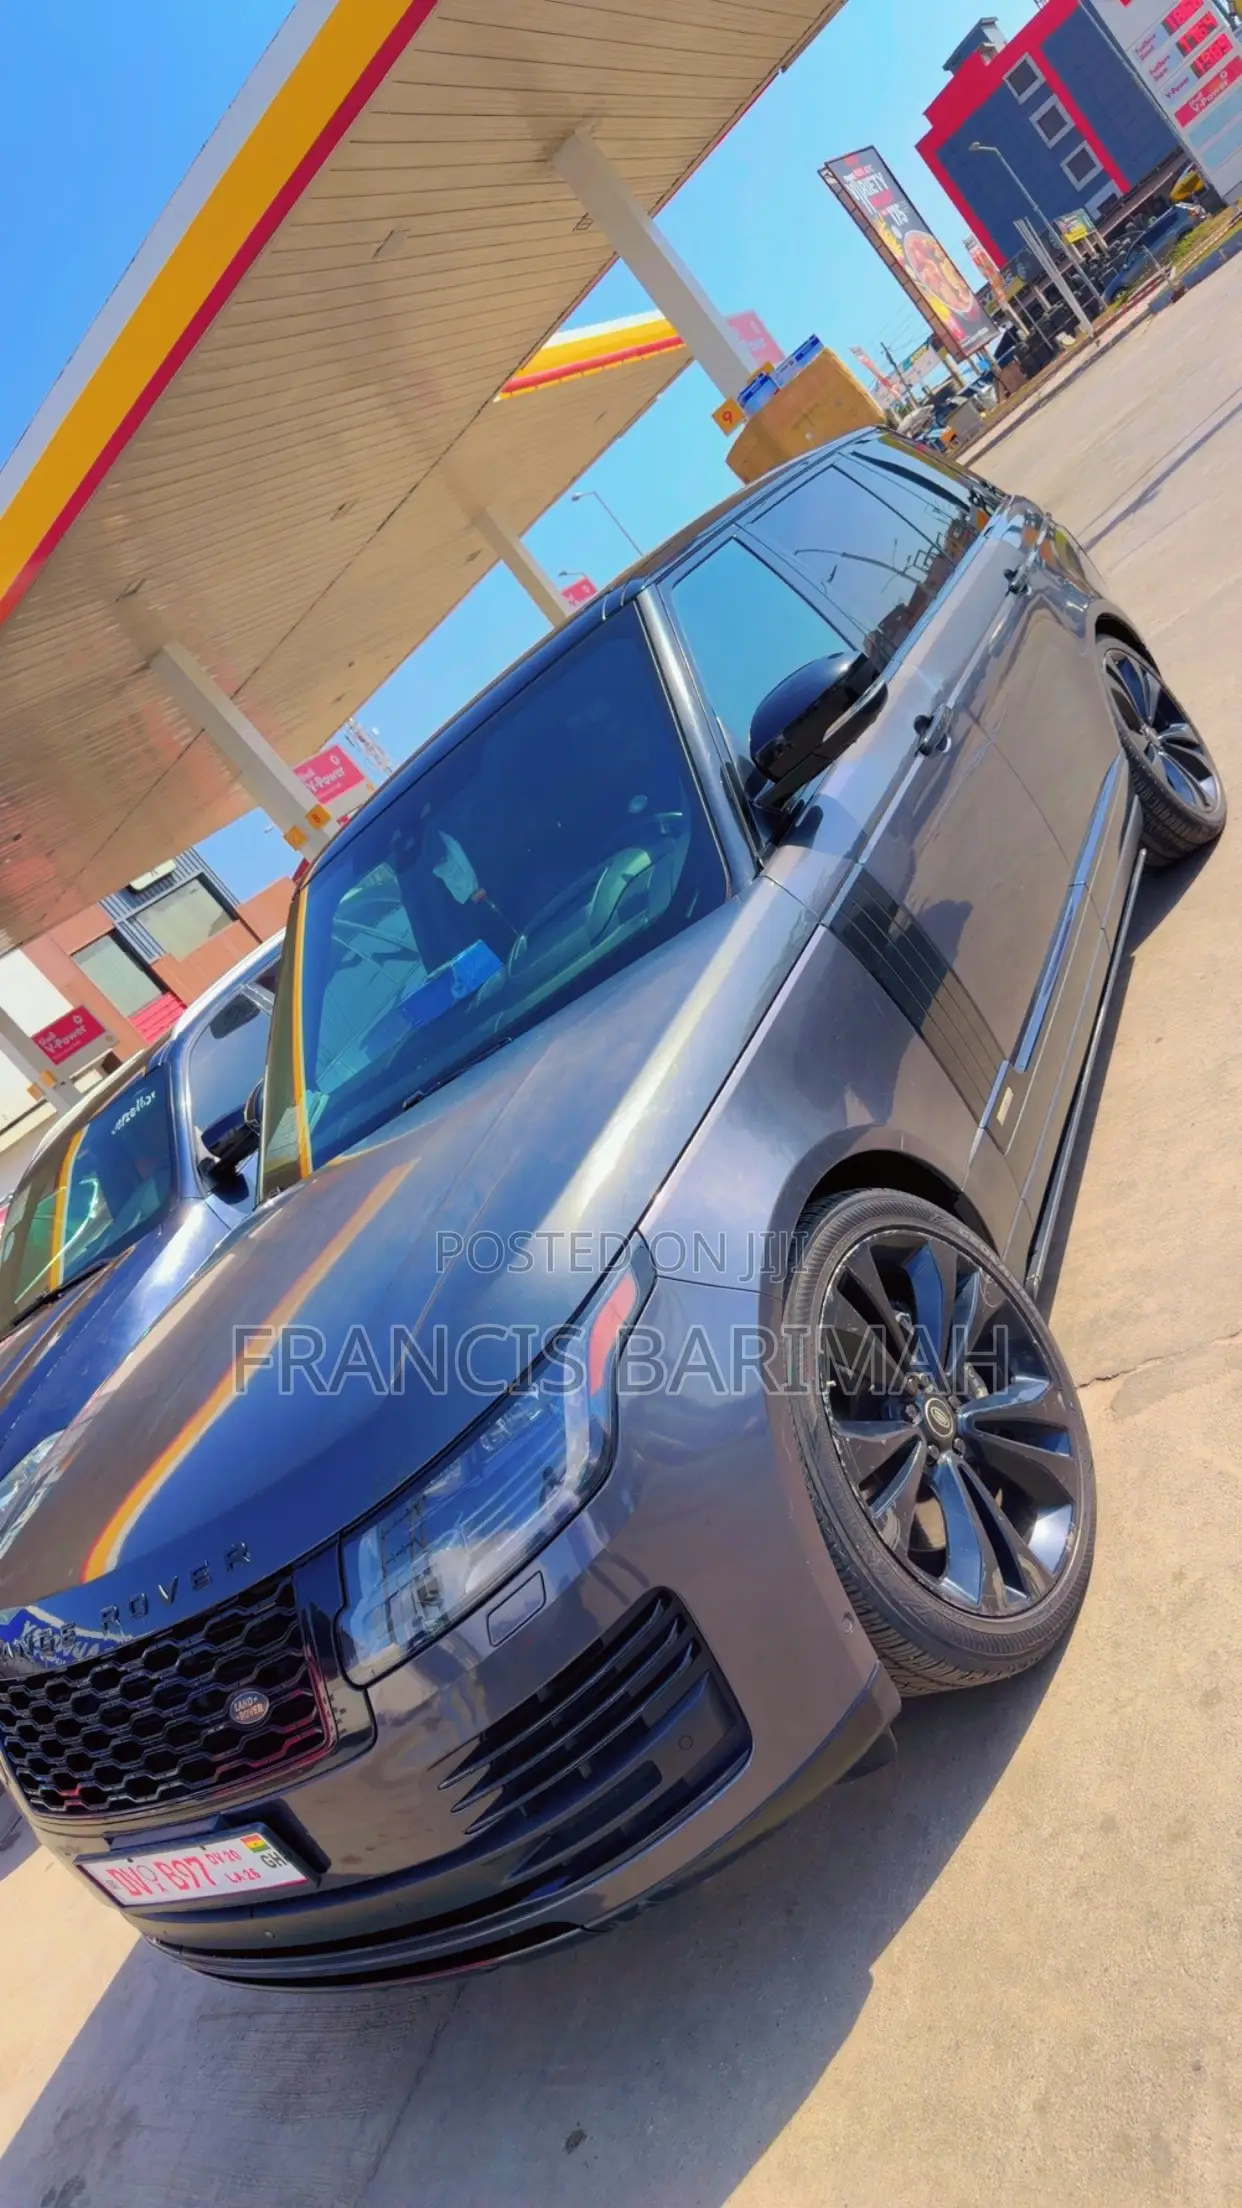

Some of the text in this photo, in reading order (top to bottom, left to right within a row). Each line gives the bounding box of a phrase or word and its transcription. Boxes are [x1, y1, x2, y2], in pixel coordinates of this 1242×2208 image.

[1164, 76, 1189, 98] V-Power
[1190, 79, 1229, 112] V-Power
[305, 766, 345, 793] V-Power
[43, 1024, 87, 1053] V-Power
[100, 1541, 251, 1637] ROVER
[234, 1696, 254, 1713] LAND
[238, 1703, 265, 1721] ROVER
[226, 1849, 242, 1861] 20
[260, 1851, 288, 1869] GH
